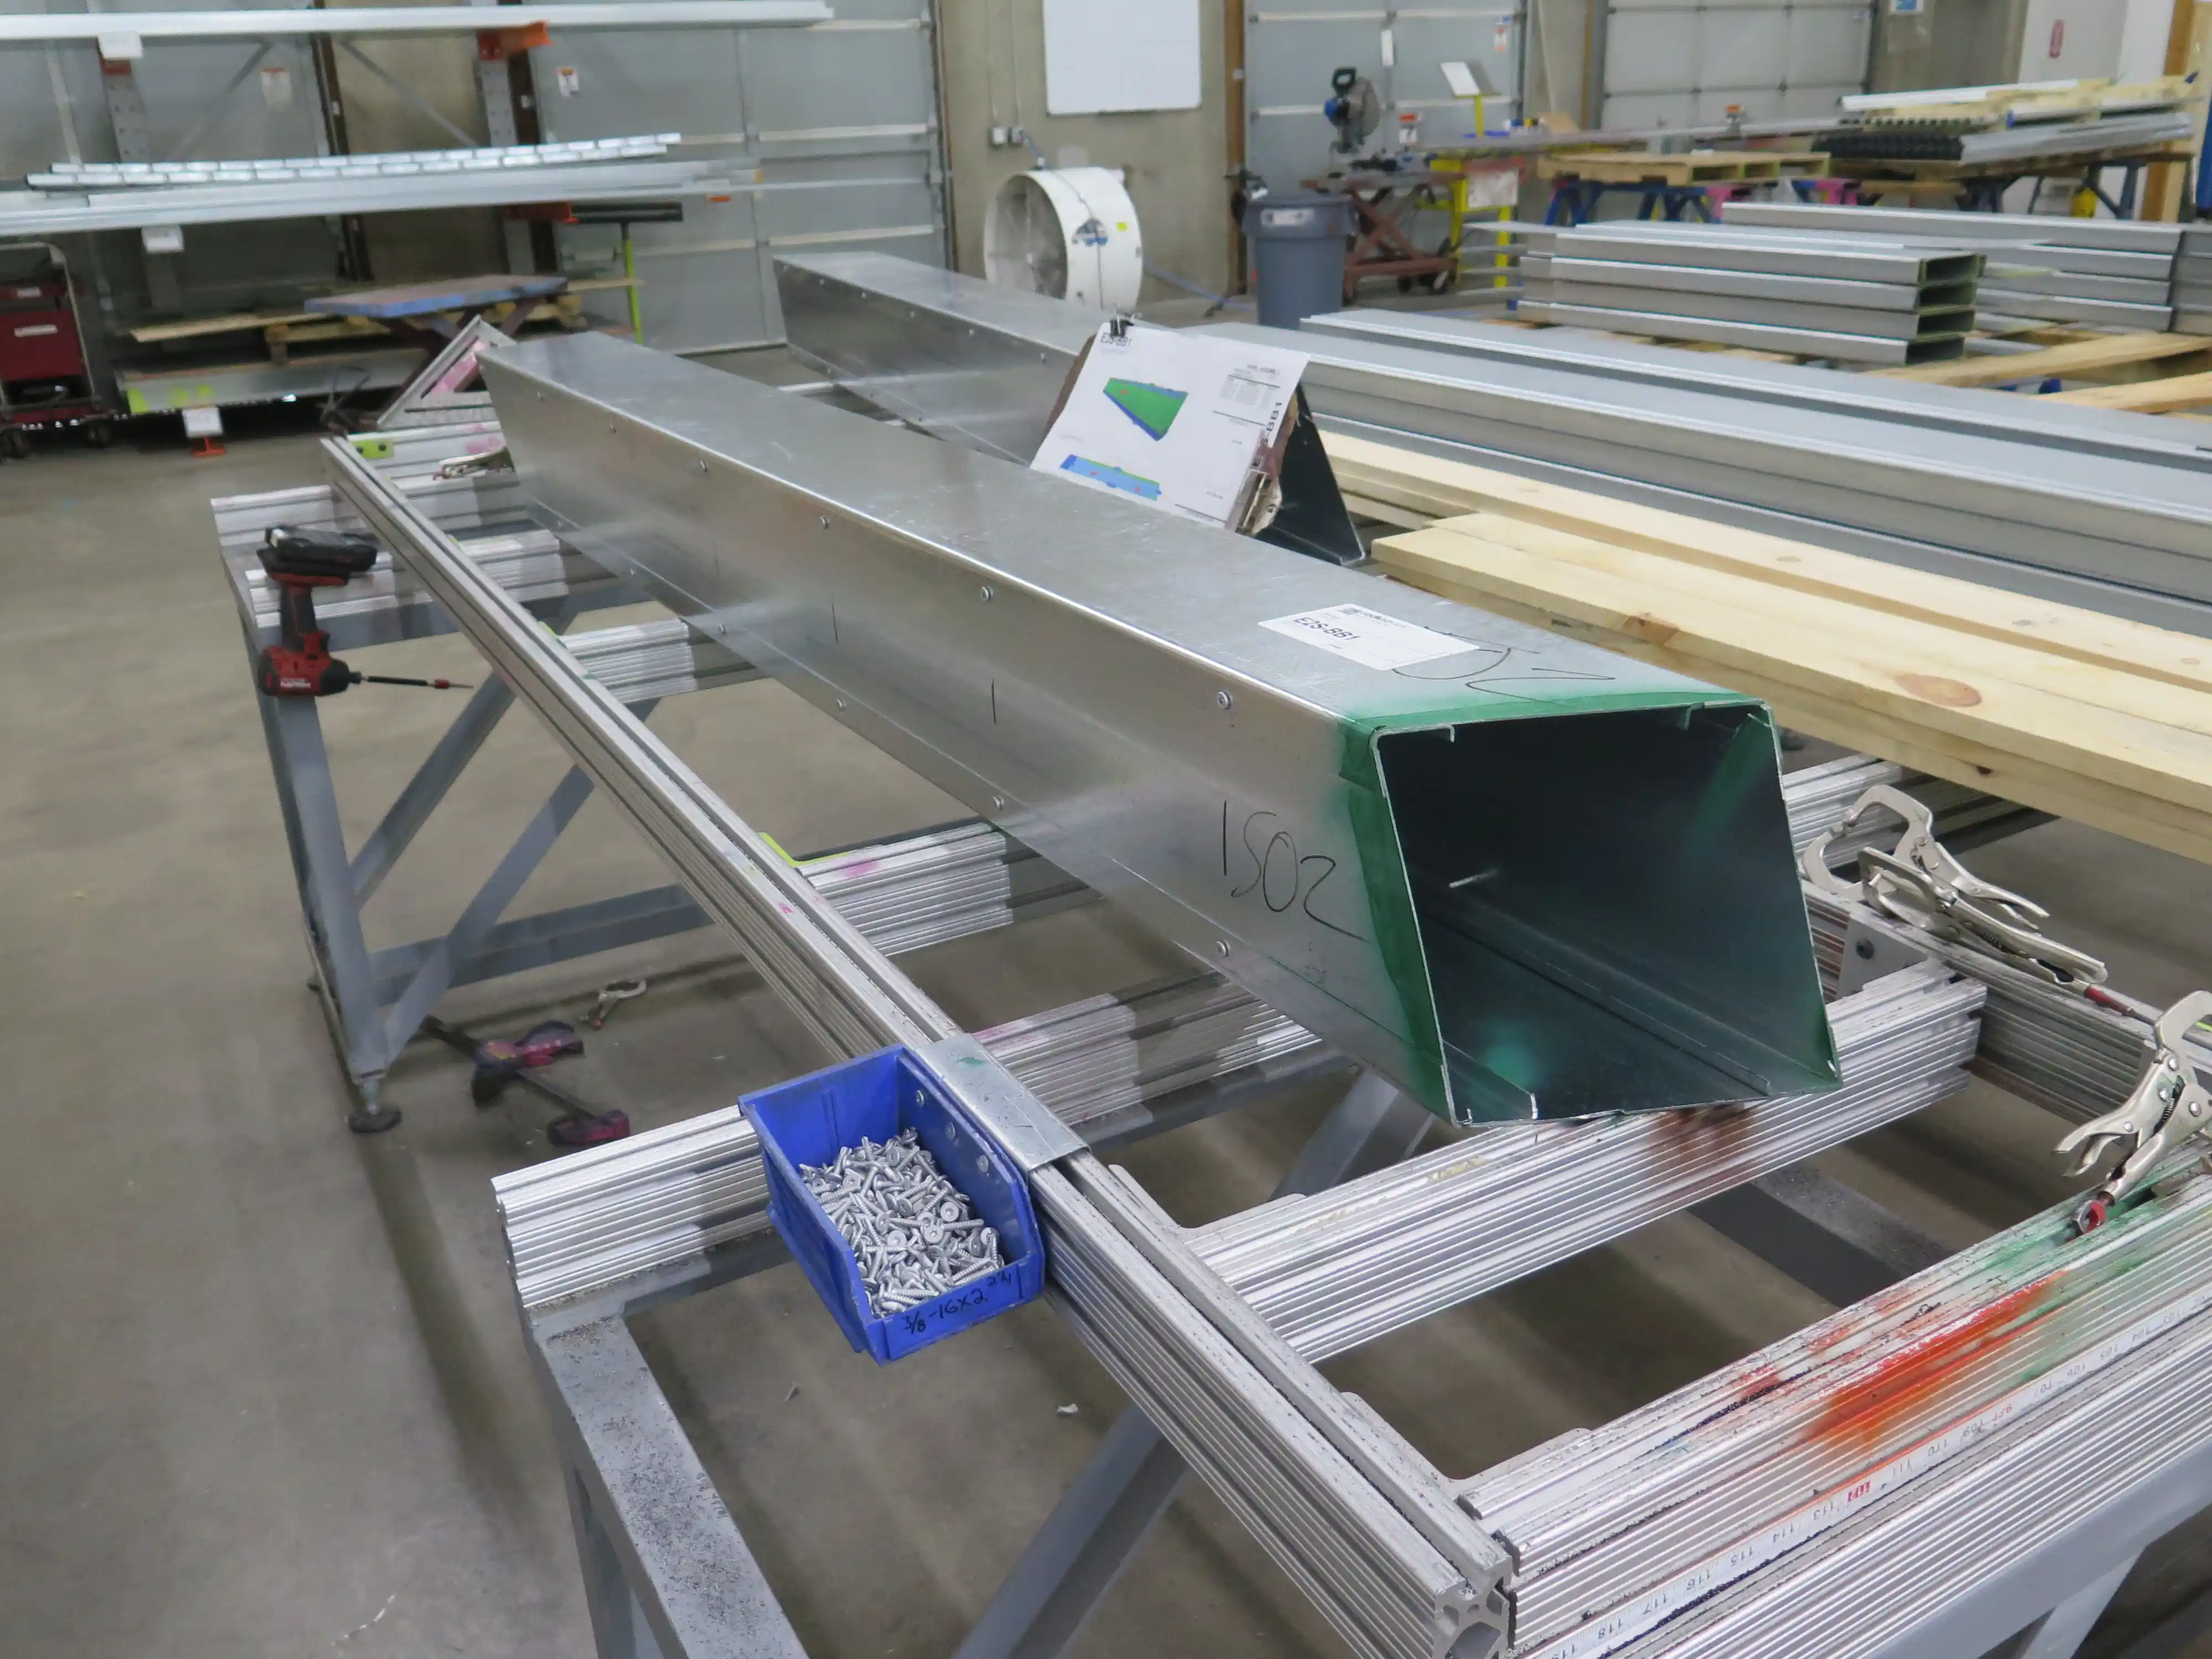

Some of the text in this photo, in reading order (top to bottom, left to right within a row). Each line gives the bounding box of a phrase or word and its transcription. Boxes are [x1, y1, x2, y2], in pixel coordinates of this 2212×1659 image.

[1293, 617, 1361, 640] E2S-BB1
[1928, 1439, 1948, 1457] 110
[1892, 1459, 1913, 1477] 111
[1813, 1502, 1834, 1521] 113
[1772, 1524, 1794, 1543] 114
[1730, 1546, 1754, 1566] 115
[1687, 1571, 1711, 1590] 116
[1643, 1594, 1668, 1616] 117
[1598, 1618, 1623, 1639] 118
